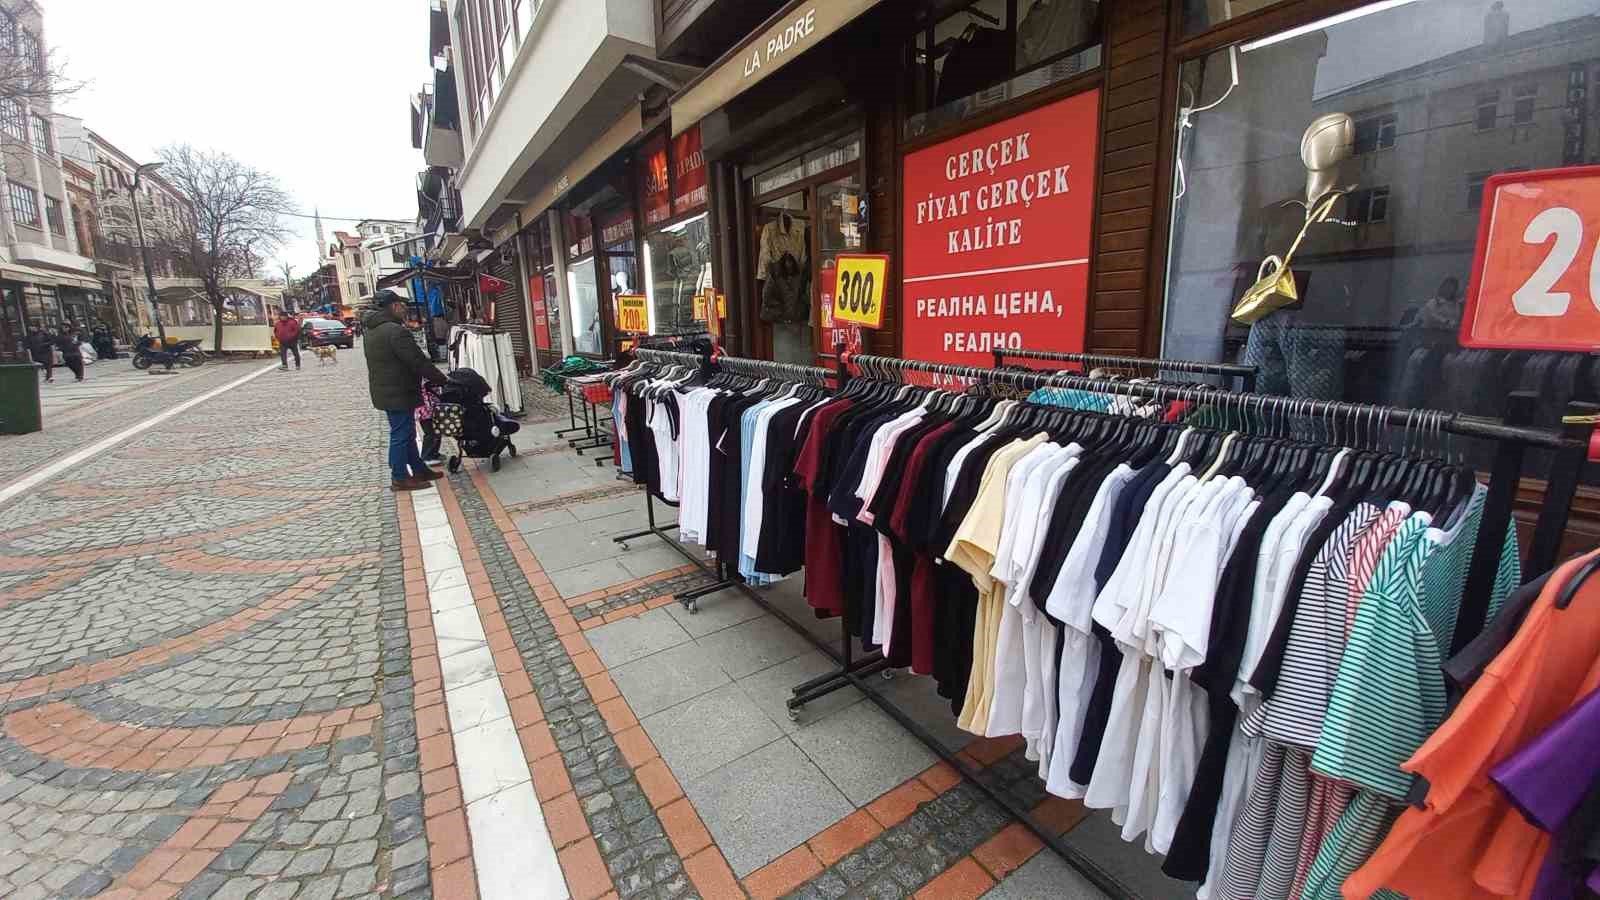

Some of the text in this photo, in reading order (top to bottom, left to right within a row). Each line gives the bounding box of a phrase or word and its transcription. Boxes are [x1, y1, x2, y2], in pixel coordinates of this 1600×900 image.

[744, 9, 815, 77] LA PADRE
[945, 132, 1031, 181] GERÇEK
[916, 165, 1071, 225] FİYAT GERÇEK
[948, 217, 1023, 254] KALİTE
[1511, 206, 1600, 317] 2
[916, 290, 1065, 319] РЕАЛНА ЦЕНА,
[943, 331, 1023, 353] РЕАЛНО
